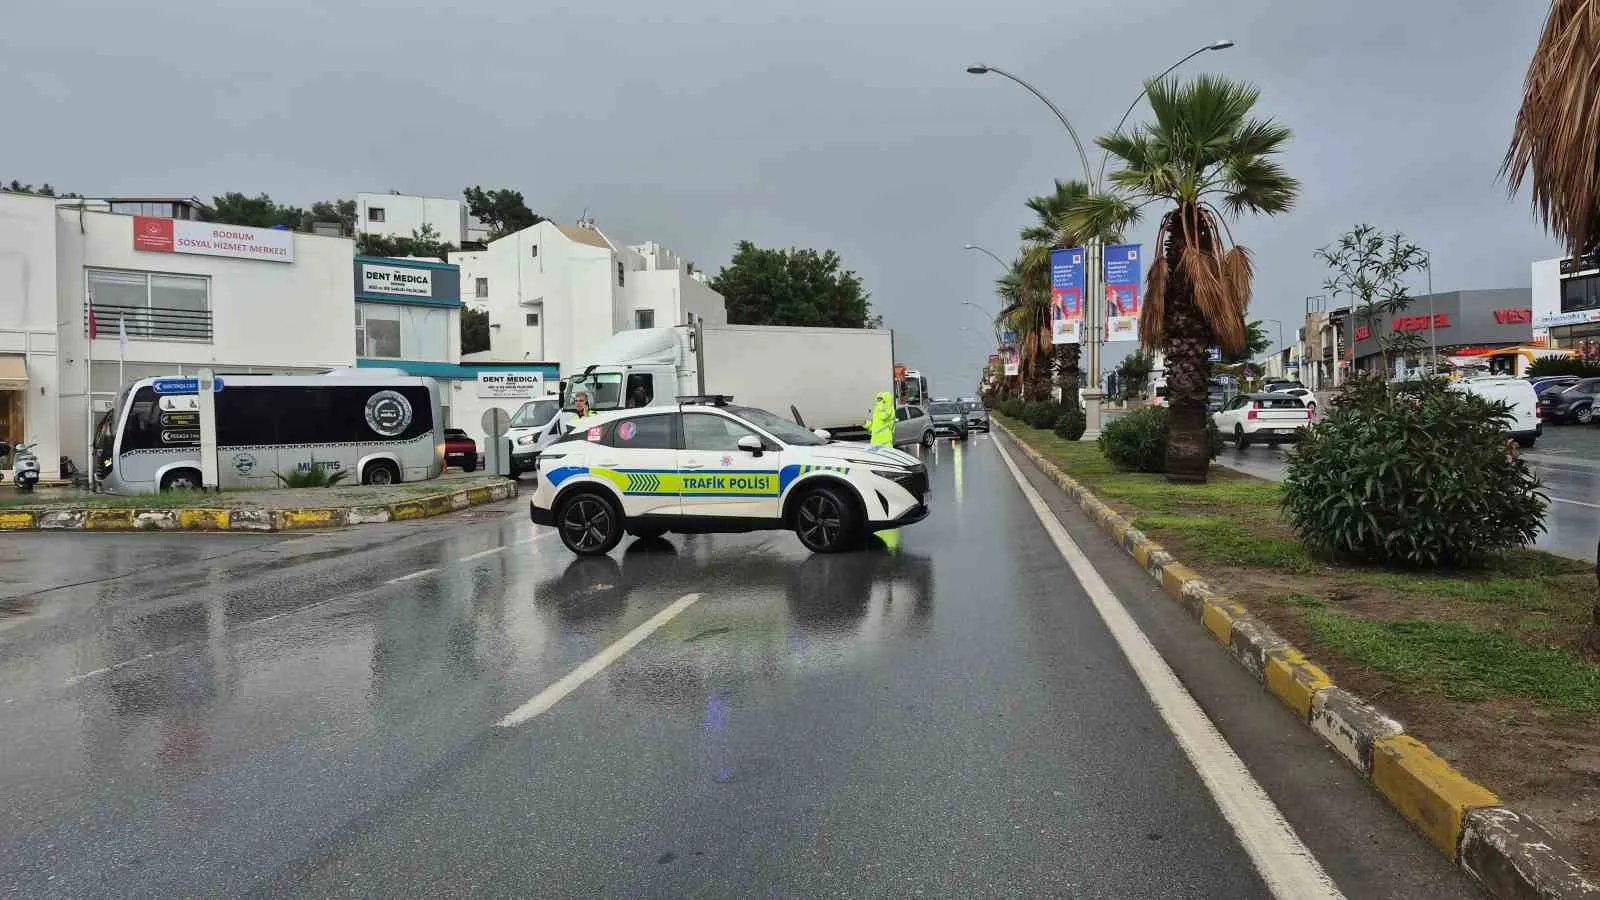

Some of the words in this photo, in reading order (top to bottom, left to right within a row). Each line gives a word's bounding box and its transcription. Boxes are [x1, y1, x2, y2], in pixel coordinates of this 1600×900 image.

[212, 230, 255, 241] BODRUM
[177, 238, 211, 249] SOSYAL
[366, 271, 391, 281] DENT
[393, 273, 428, 284] MEDICA
[682, 475, 726, 489] TRAFİK
[729, 475, 770, 489] POLİSİ
